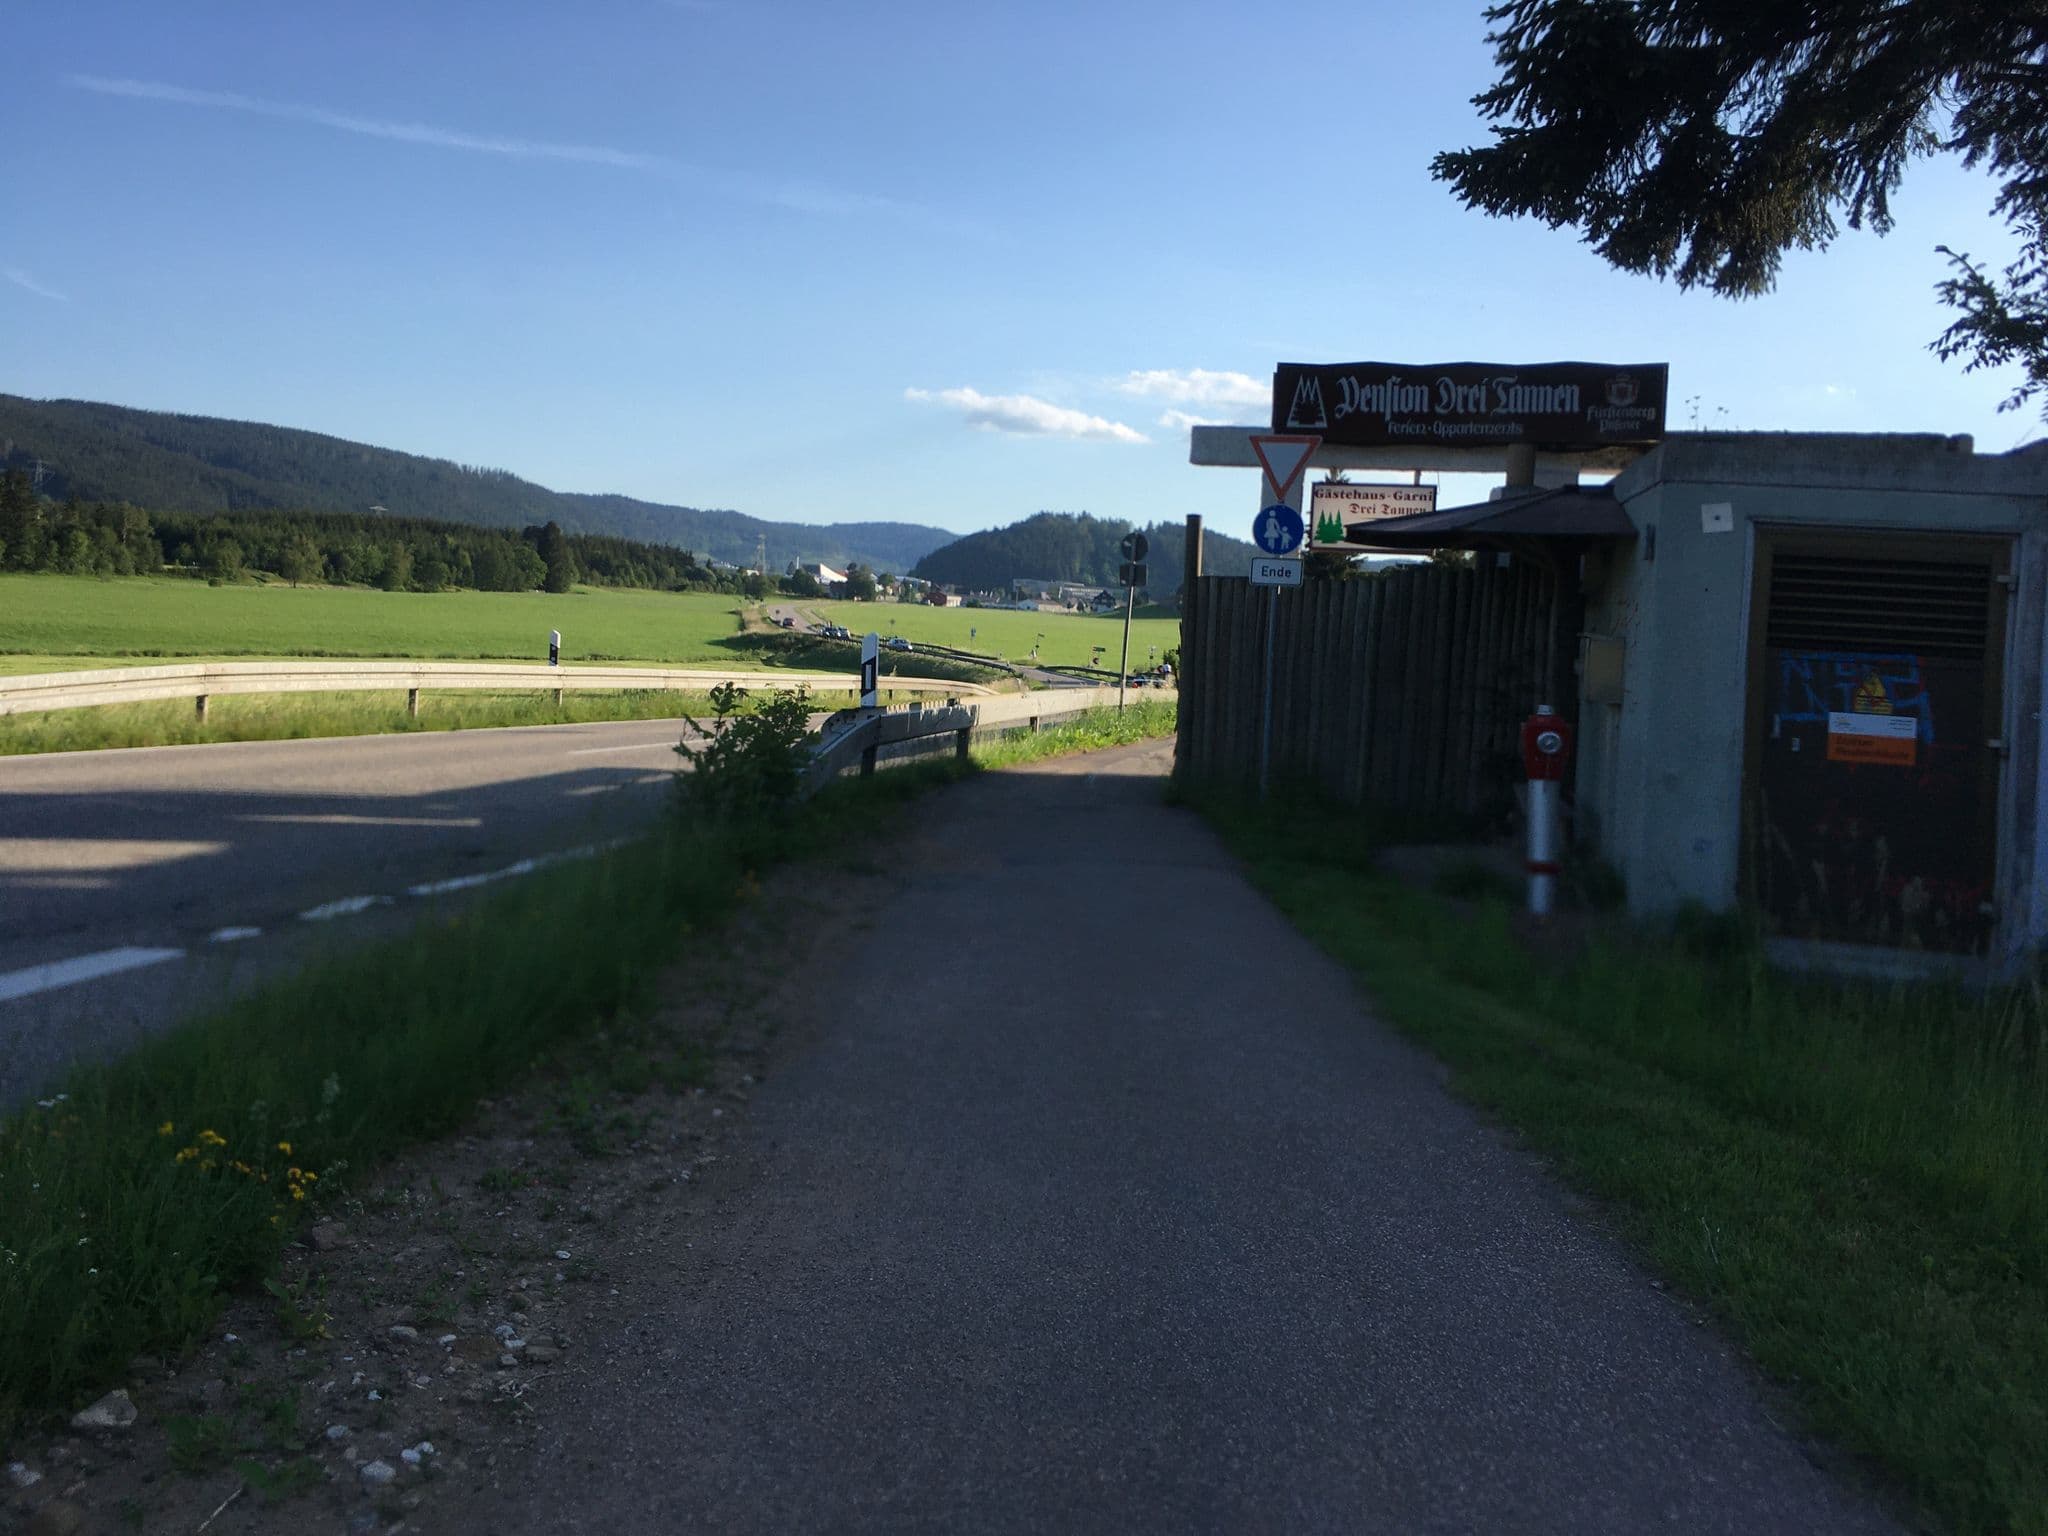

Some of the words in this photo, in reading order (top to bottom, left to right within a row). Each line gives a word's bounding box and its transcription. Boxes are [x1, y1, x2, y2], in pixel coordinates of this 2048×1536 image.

[1335, 375, 1428, 421] Pension
[1435, 376, 1488, 414] Drei
[1491, 375, 1580, 416] Tannen
[1349, 503, 1377, 514] Drei
[1261, 566, 1292, 578] Ende
